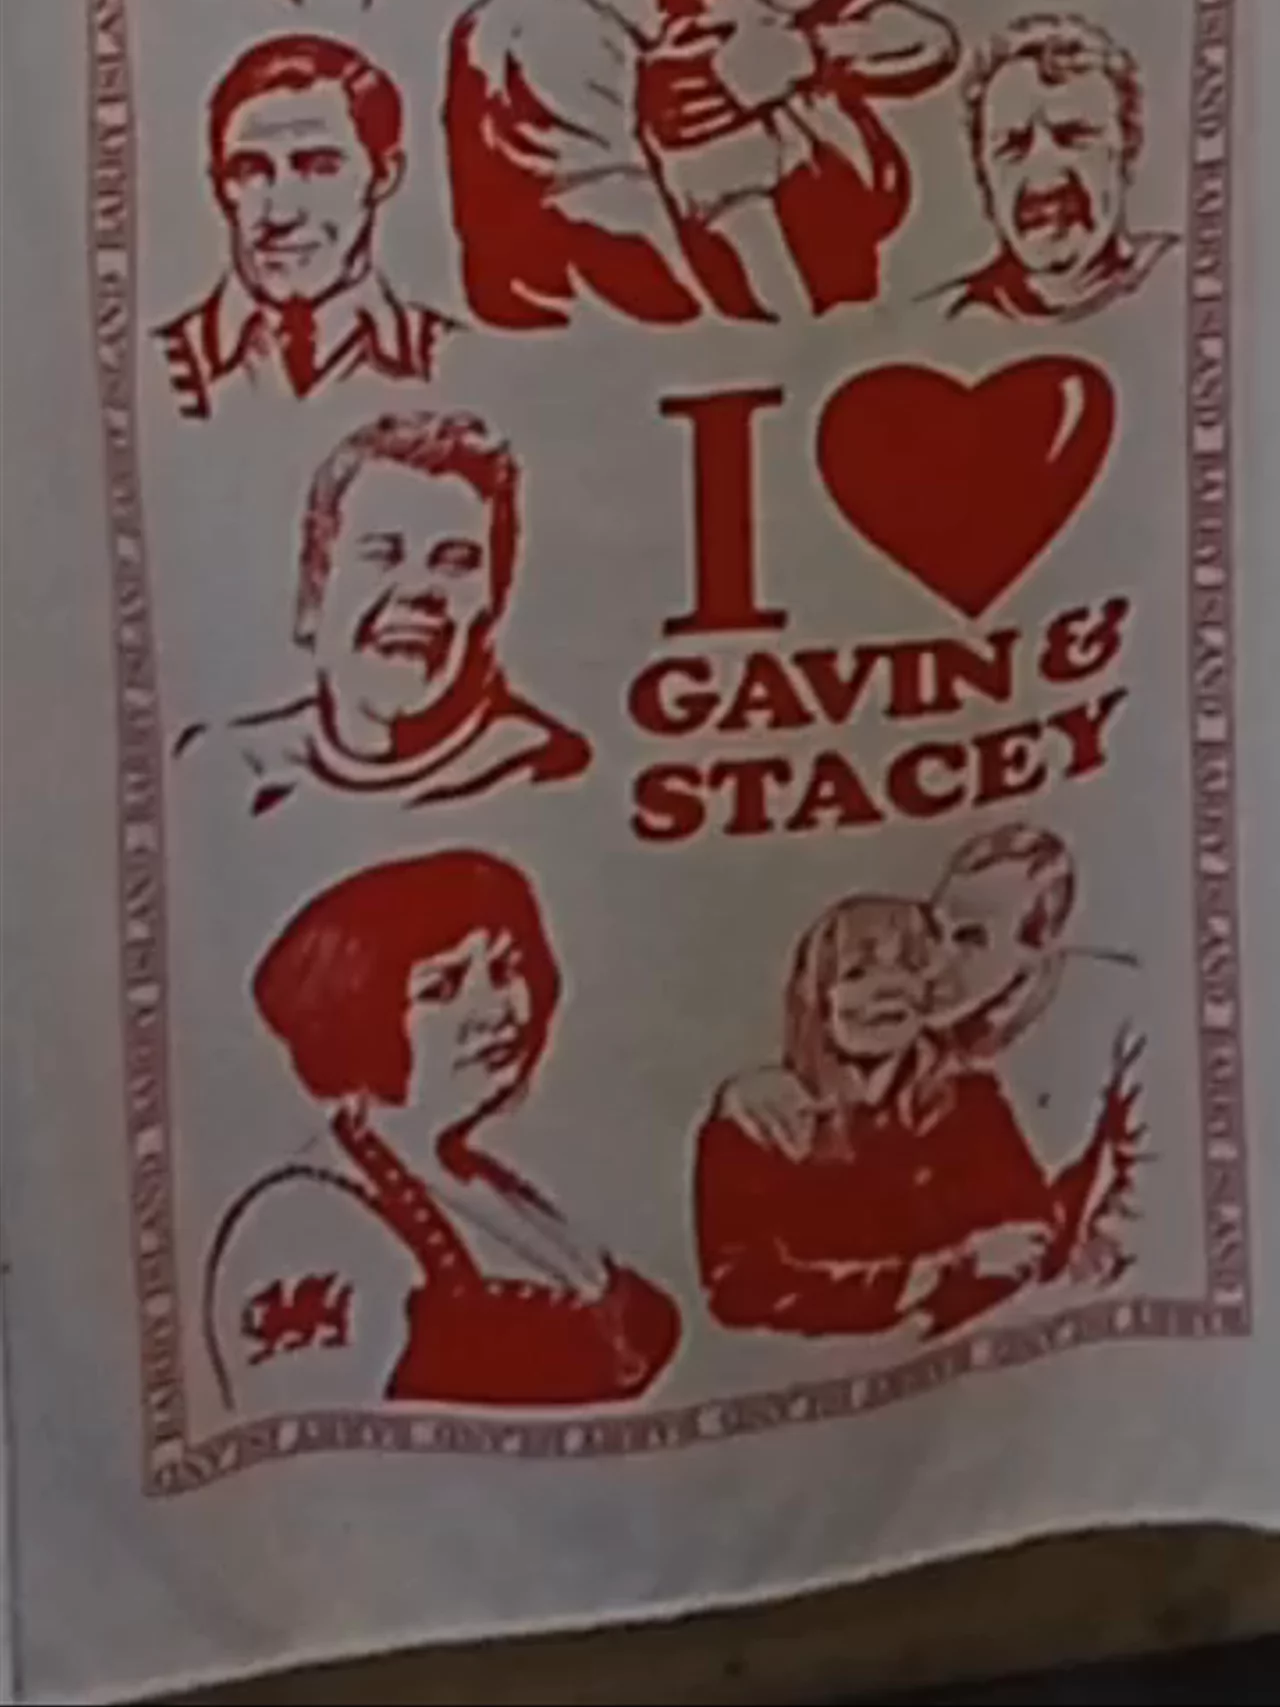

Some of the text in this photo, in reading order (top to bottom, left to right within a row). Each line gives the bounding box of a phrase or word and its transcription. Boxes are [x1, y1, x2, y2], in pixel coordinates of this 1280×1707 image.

[658, 386, 788, 638] I
[626, 597, 1130, 735] GAVIN &
[630, 686, 1130, 843] STACEY
